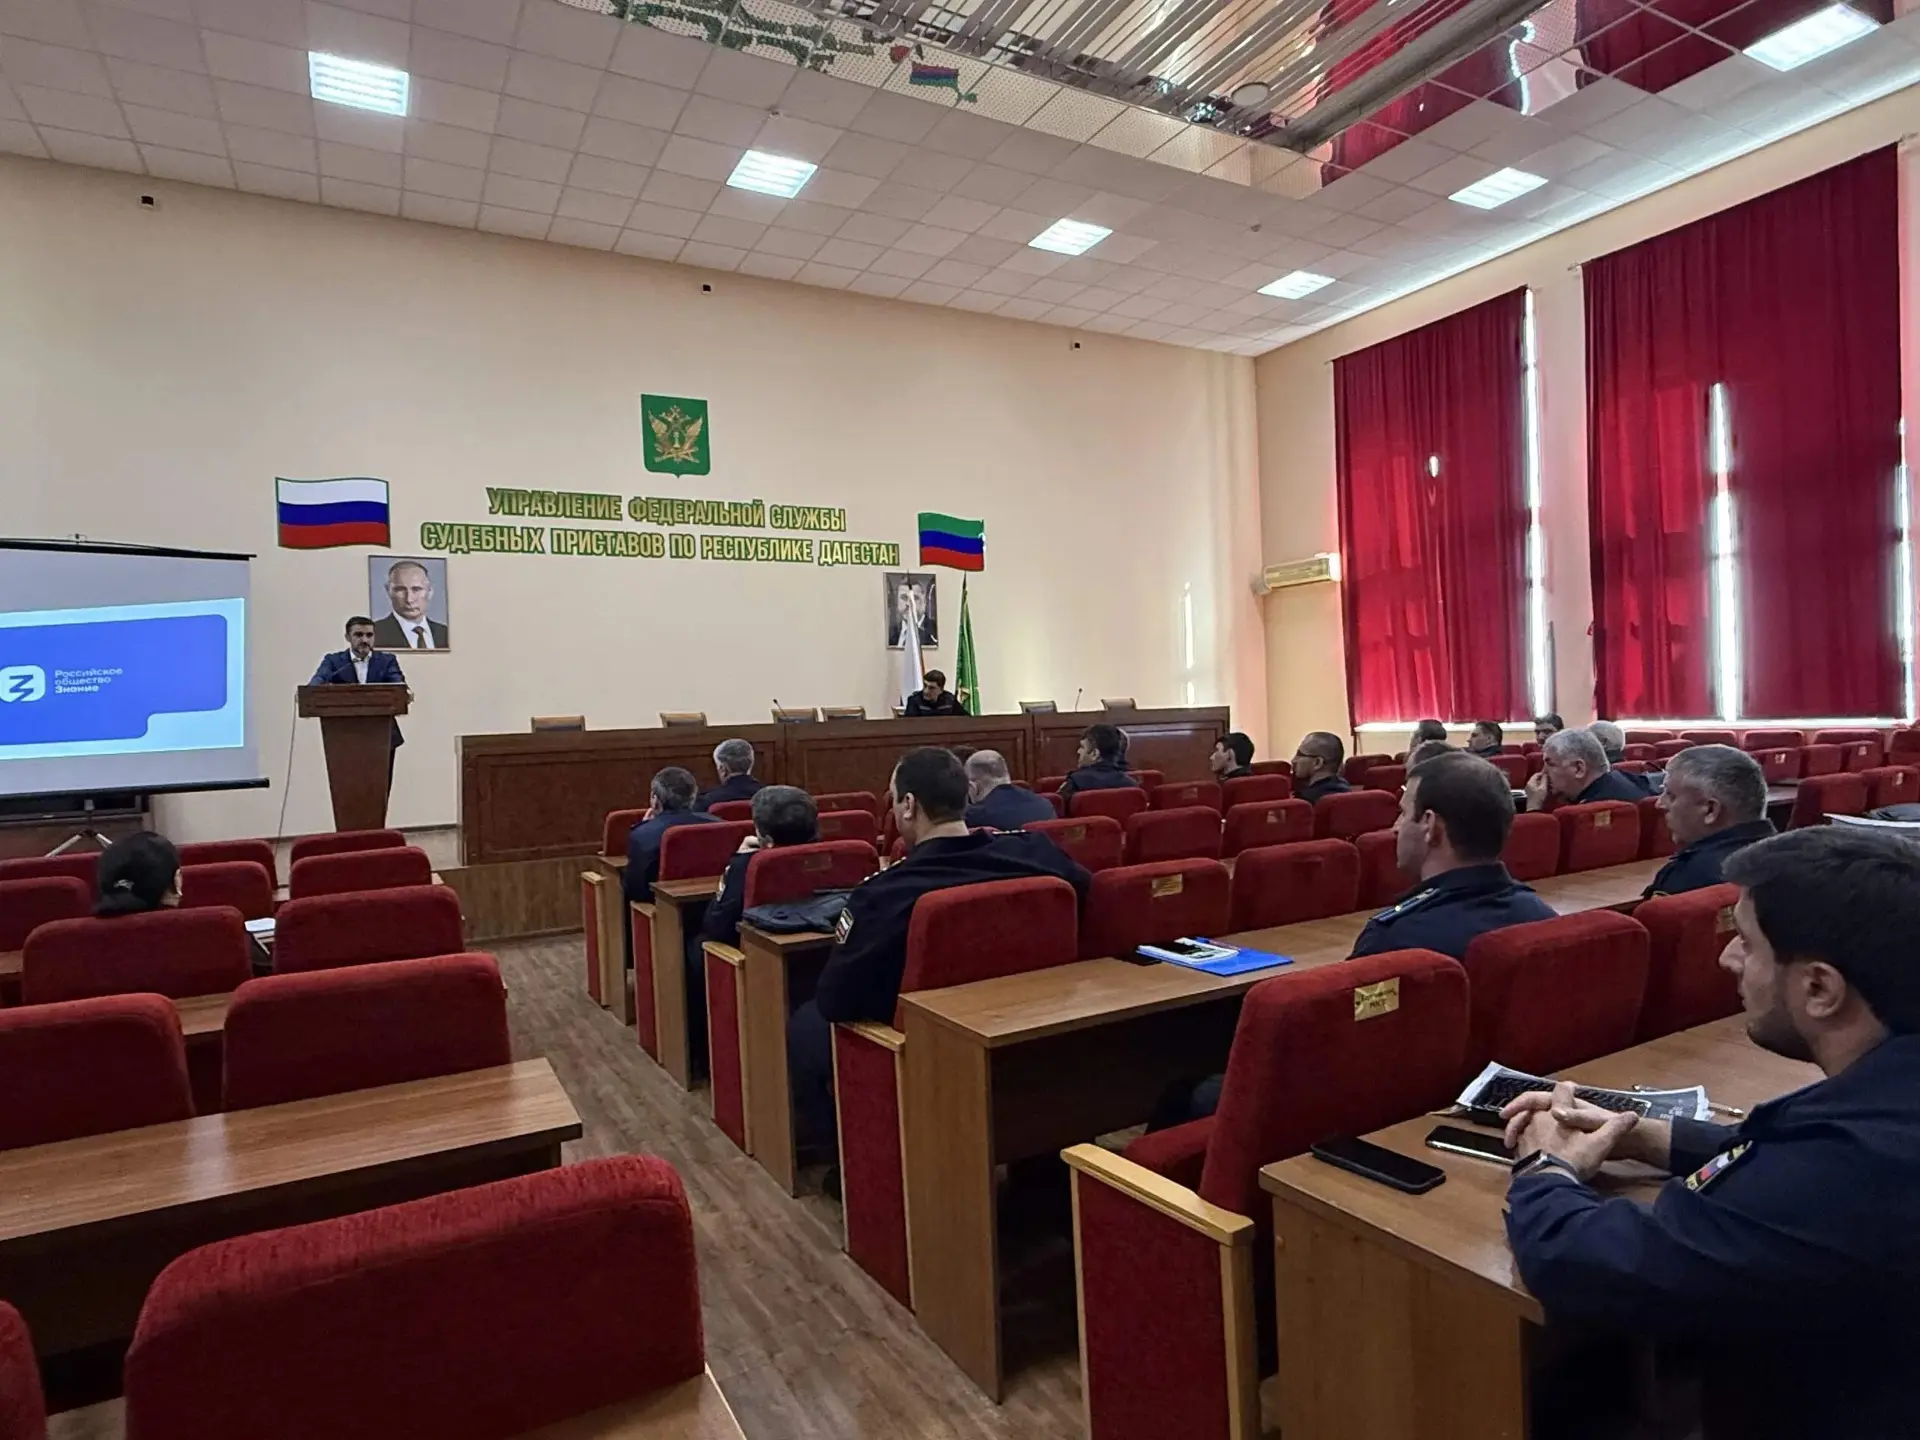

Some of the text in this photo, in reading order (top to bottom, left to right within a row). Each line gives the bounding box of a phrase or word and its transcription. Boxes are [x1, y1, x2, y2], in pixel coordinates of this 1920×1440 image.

[486, 487, 846, 532] УПРАВЛЕНИЕ ФЕДЕРАЛЬНОЙ СЛУЖБЫ
[421, 522, 900, 567] СУДЕБНЫХ ПРИСТАВОВ ПО РЕСПУБЛИКЕ ДАГЕСТАН
[55, 668, 123, 679] Российское
[55, 676, 112, 686] общество
[55, 685, 100, 694] Знание
